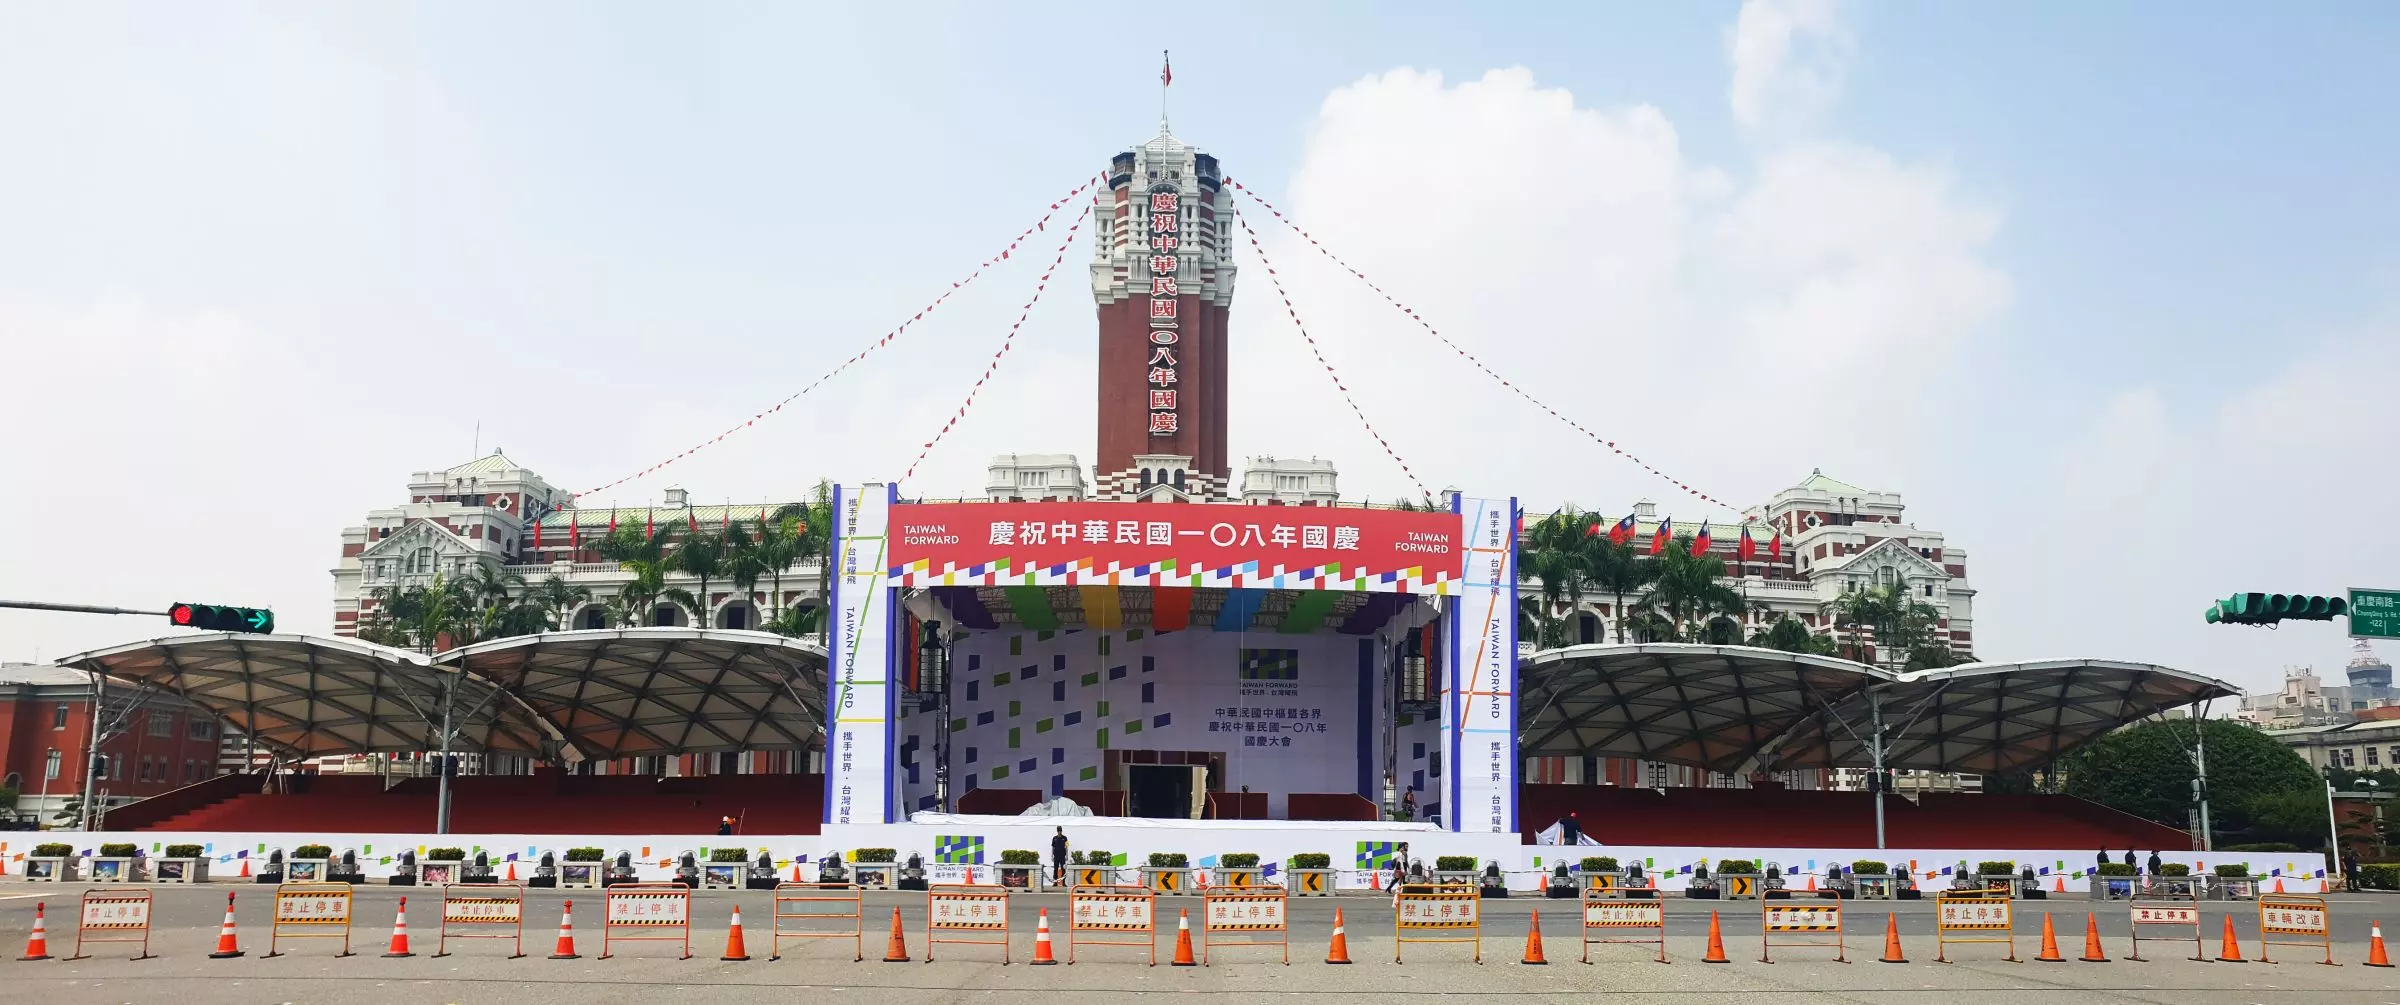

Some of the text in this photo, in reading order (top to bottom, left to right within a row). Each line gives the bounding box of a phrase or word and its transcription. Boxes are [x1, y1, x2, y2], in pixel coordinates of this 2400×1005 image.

[904, 525, 946, 534] TAIWAN
[904, 535, 960, 545] FORWARD
[1408, 532, 1449, 543] TAIWAN
[1395, 542, 1449, 554] FORWARD
[844, 607, 855, 709] TAIWAN FORWARD
[1491, 618, 1500, 719] TAIWAN FORWARD
[1245, 735, 1292, 747] 國慶大會
[283, 900, 343, 913] 禁止停車
[617, 903, 679, 915] 禁止停車
[939, 904, 998, 917] 禁止停車
[1081, 904, 1142, 918] 禁止停車
[1215, 906, 1276, 919] 禁止停車
[1404, 903, 1471, 917] 禁止停車
[1945, 907, 2003, 920] 禁止停車
[2141, 910, 2188, 920] 禁止停車
[2267, 911, 2321, 926] 車輛改道
